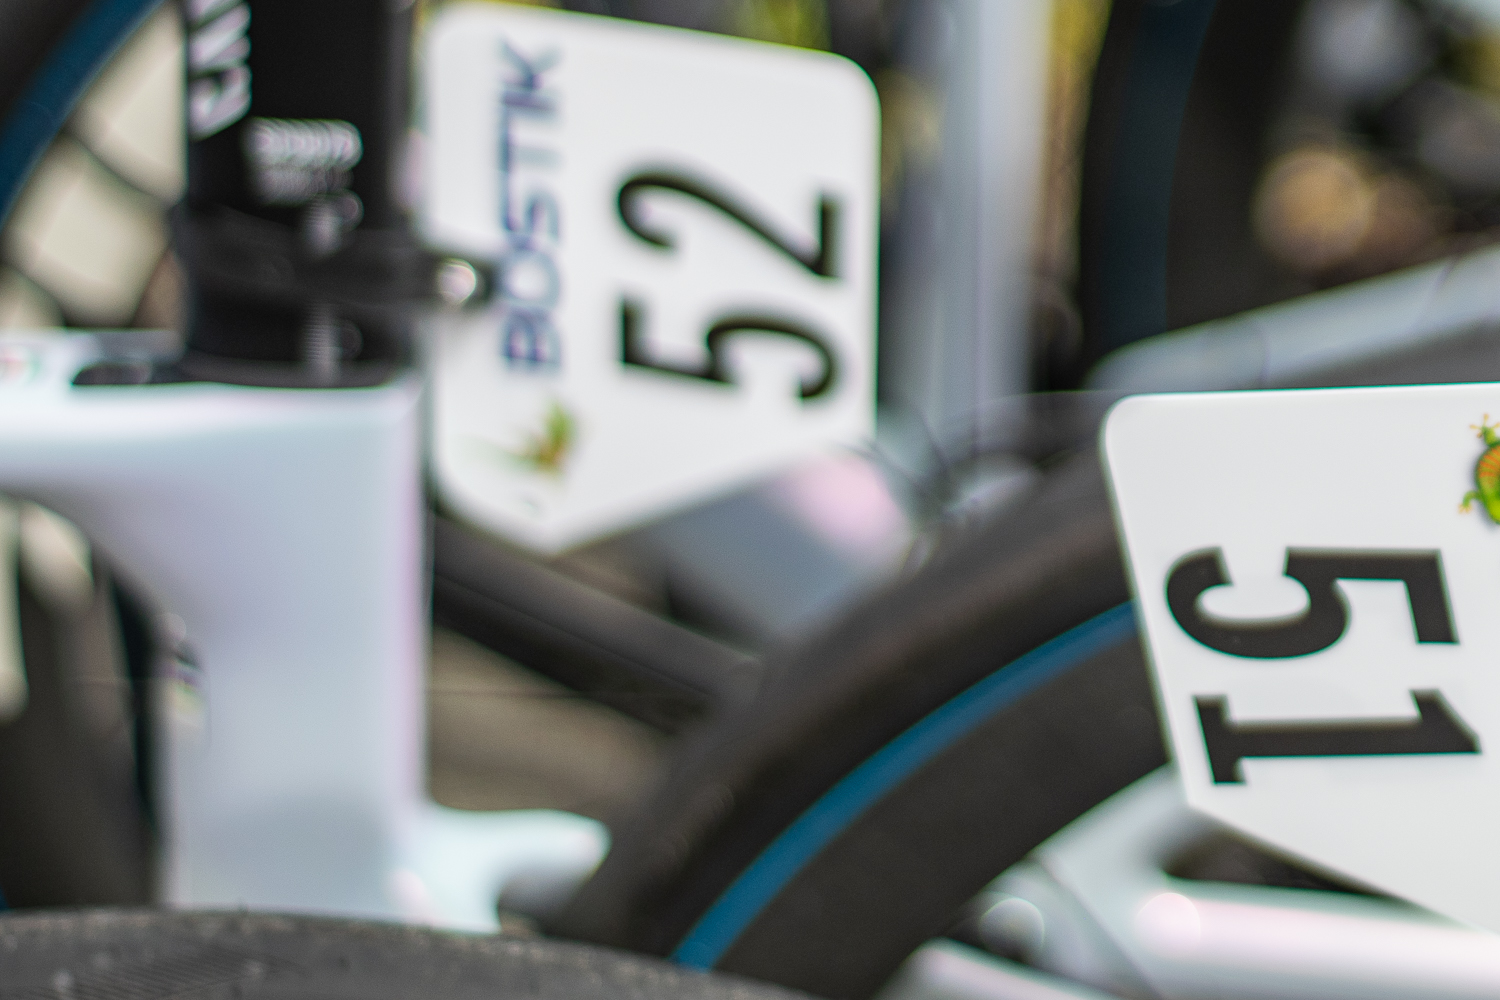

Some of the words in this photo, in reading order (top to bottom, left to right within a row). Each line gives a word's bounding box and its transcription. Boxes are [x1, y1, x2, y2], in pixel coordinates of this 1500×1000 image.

[496, 36, 564, 374] BOSTIK
[615, 162, 845, 402] 52
[1164, 545, 1483, 788] 51
